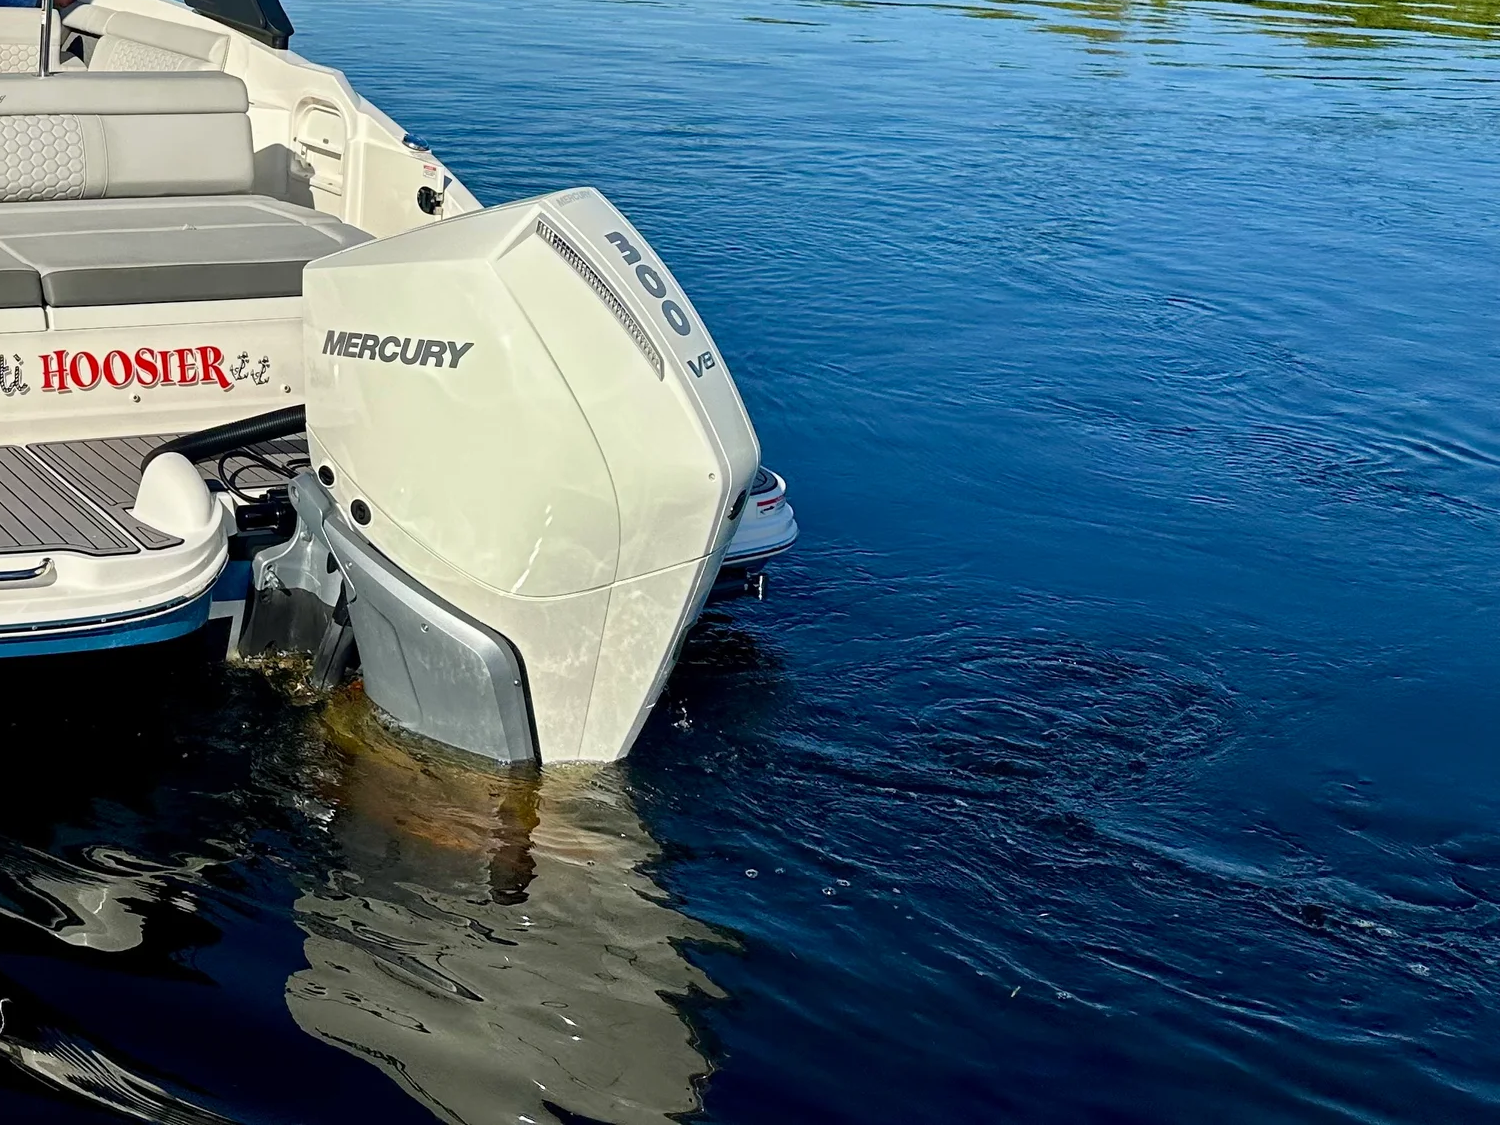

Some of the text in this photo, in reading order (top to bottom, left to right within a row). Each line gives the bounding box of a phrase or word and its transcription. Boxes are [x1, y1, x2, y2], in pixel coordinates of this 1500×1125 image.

[556, 190, 592, 207] MERCURY
[604, 231, 692, 337] 300
[38, 345, 232, 393] HOOSIER
[322, 330, 475, 369] MERCURY
[686, 351, 716, 379] V8
